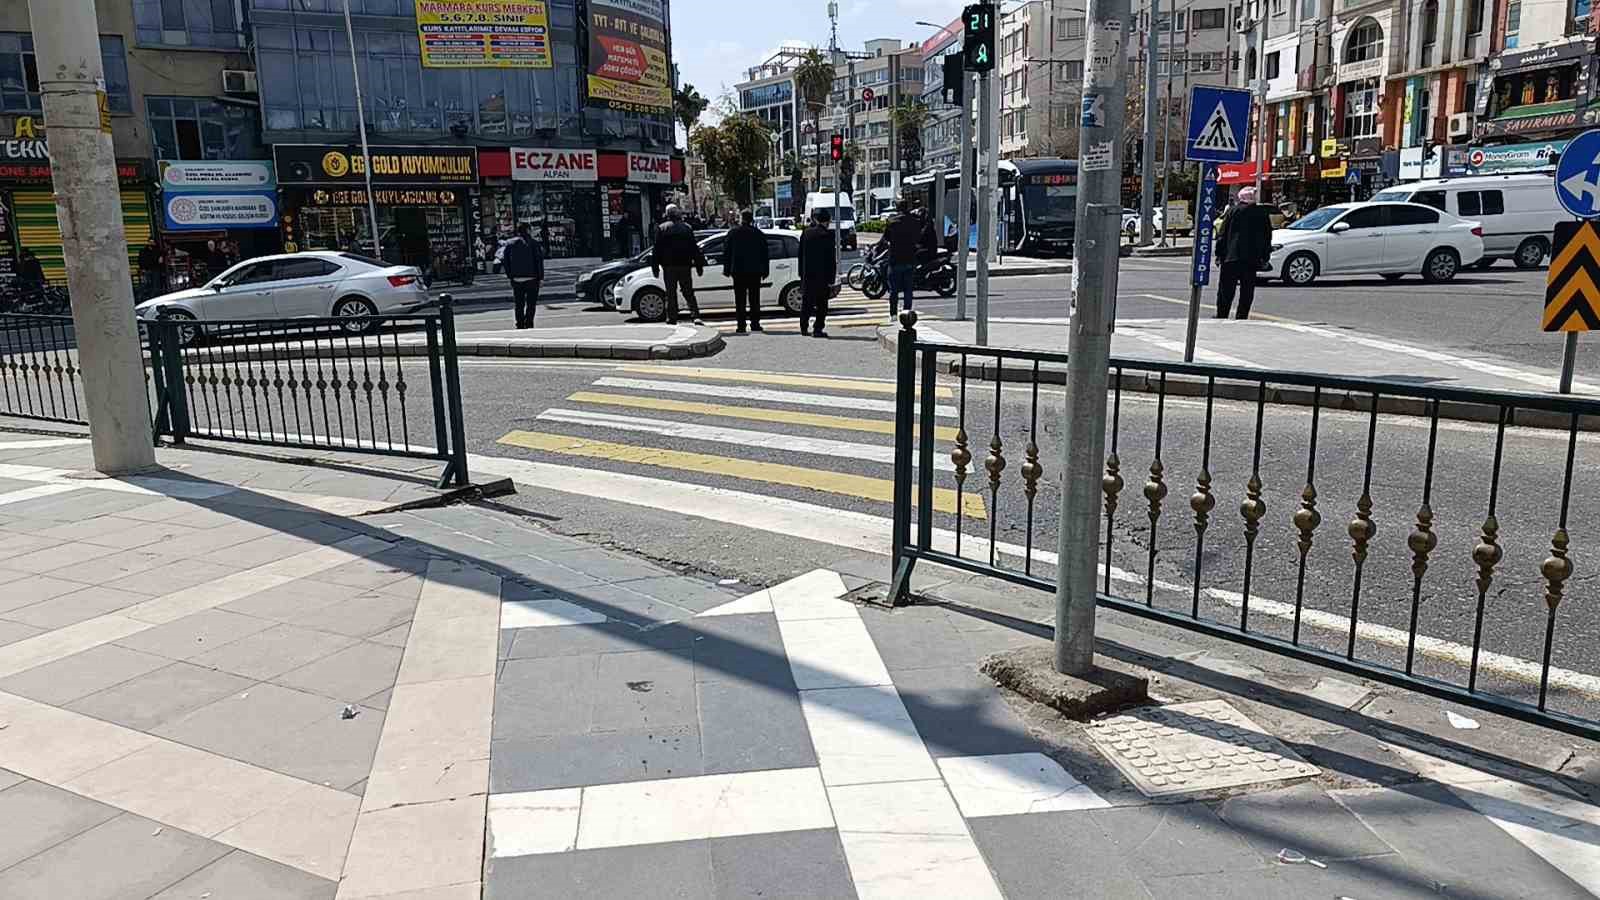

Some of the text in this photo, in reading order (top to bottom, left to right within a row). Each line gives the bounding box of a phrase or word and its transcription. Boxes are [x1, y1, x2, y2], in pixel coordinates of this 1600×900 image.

[593, 14, 608, 29] TYT
[970, 13, 989, 30] 21
[372, 155, 400, 174] GOLD
[401, 155, 472, 175] KUYUMCULUK
[515, 151, 594, 170] ECZANE
[631, 154, 670, 173] ECZANE
[351, 190, 368, 204] GOL
[1203, 187, 1213, 222] YAYA
